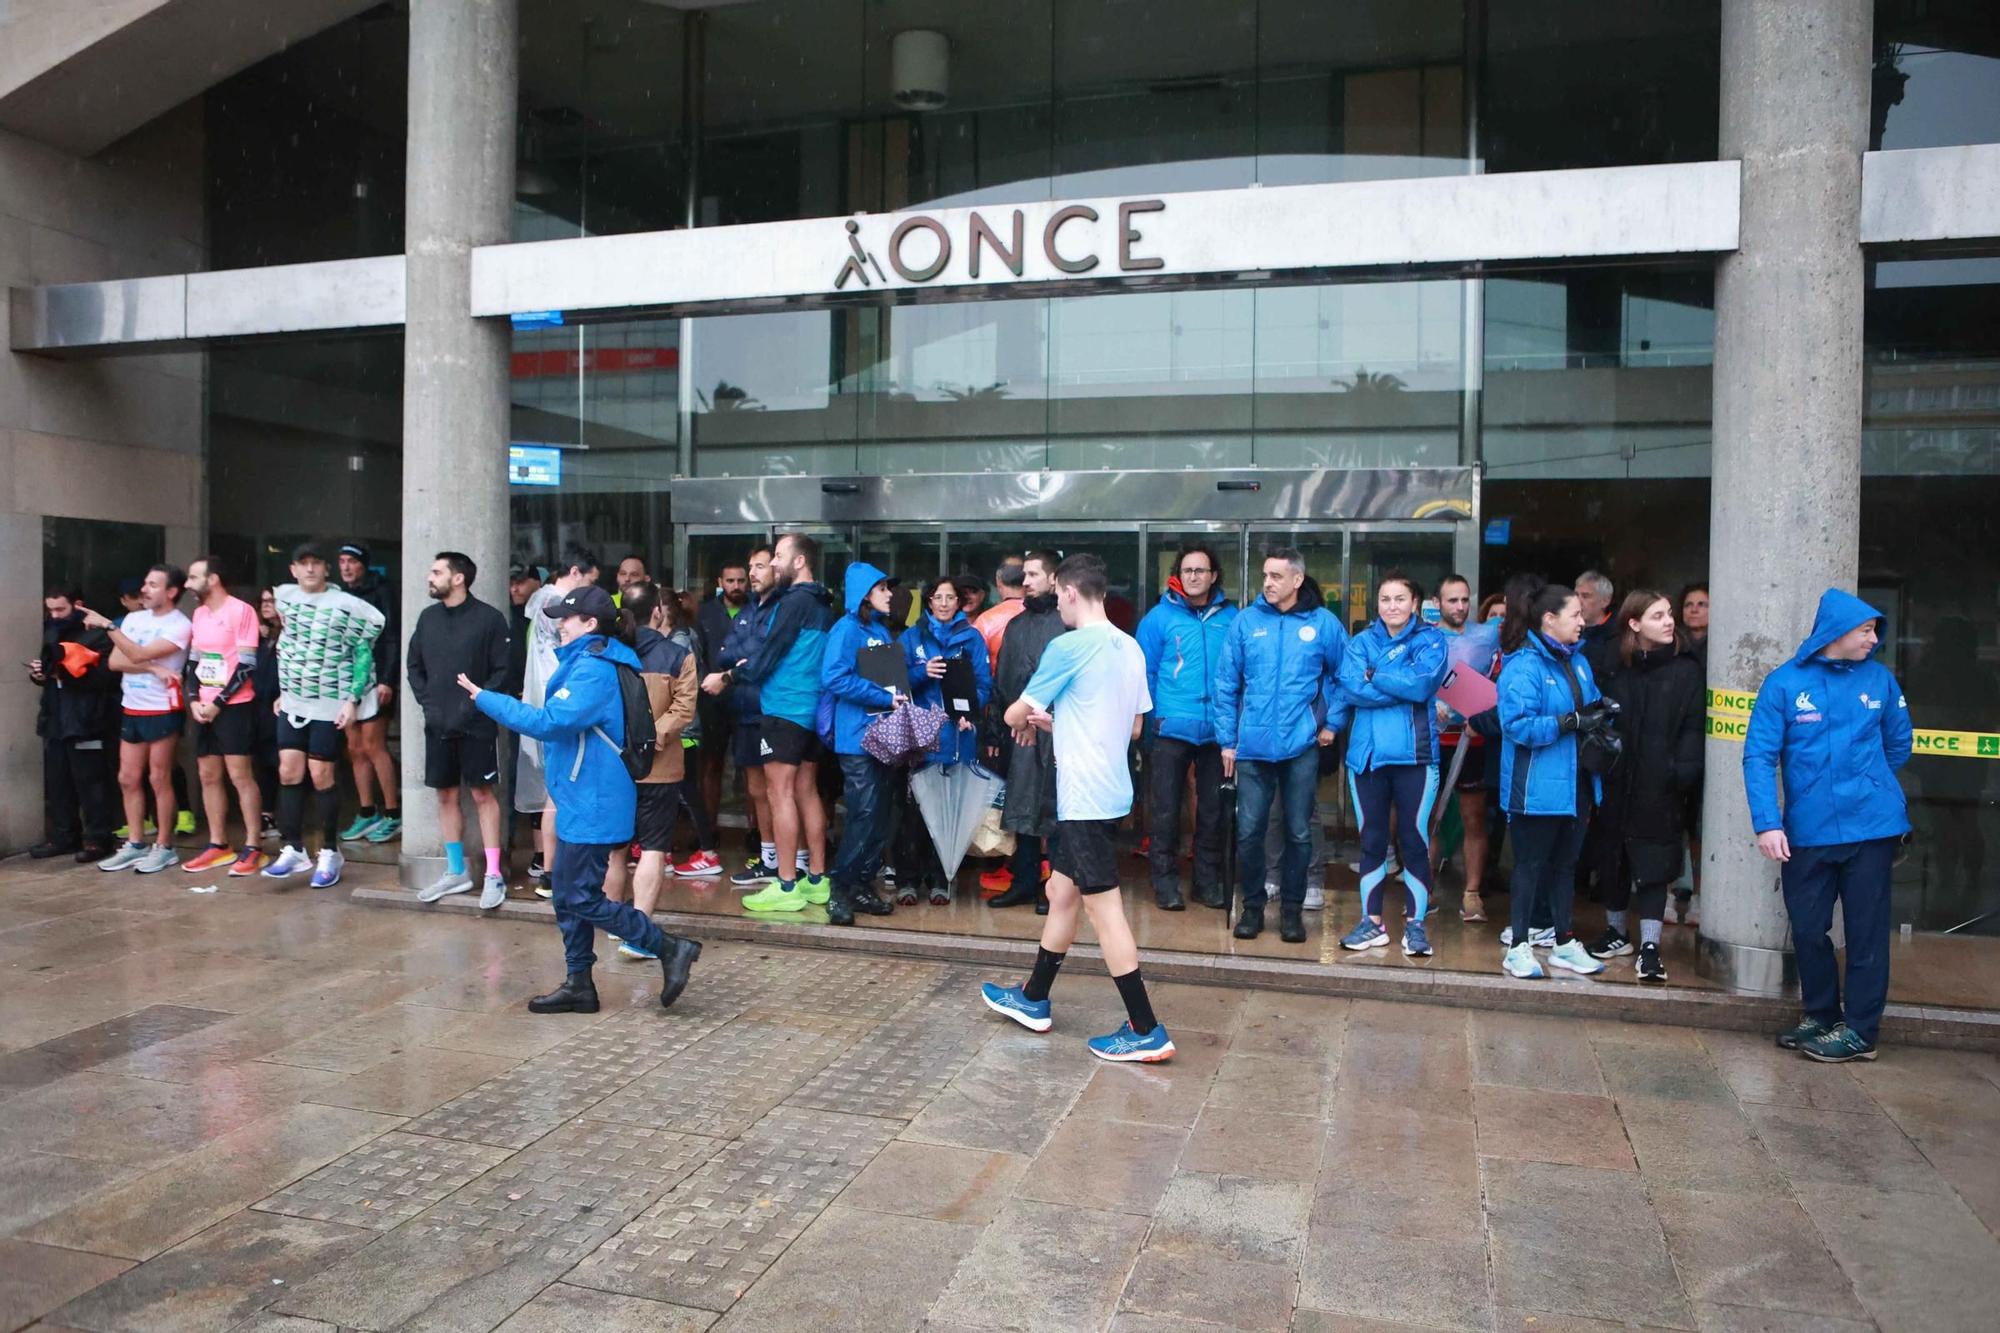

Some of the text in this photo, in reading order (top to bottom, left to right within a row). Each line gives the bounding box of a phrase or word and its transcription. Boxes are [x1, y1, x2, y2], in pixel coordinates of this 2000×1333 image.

[888, 200, 1165, 282] ONCE
[1714, 694, 1757, 711] ONCE
[1714, 721, 1747, 736] ONC
[1916, 735, 1960, 751] NCE
